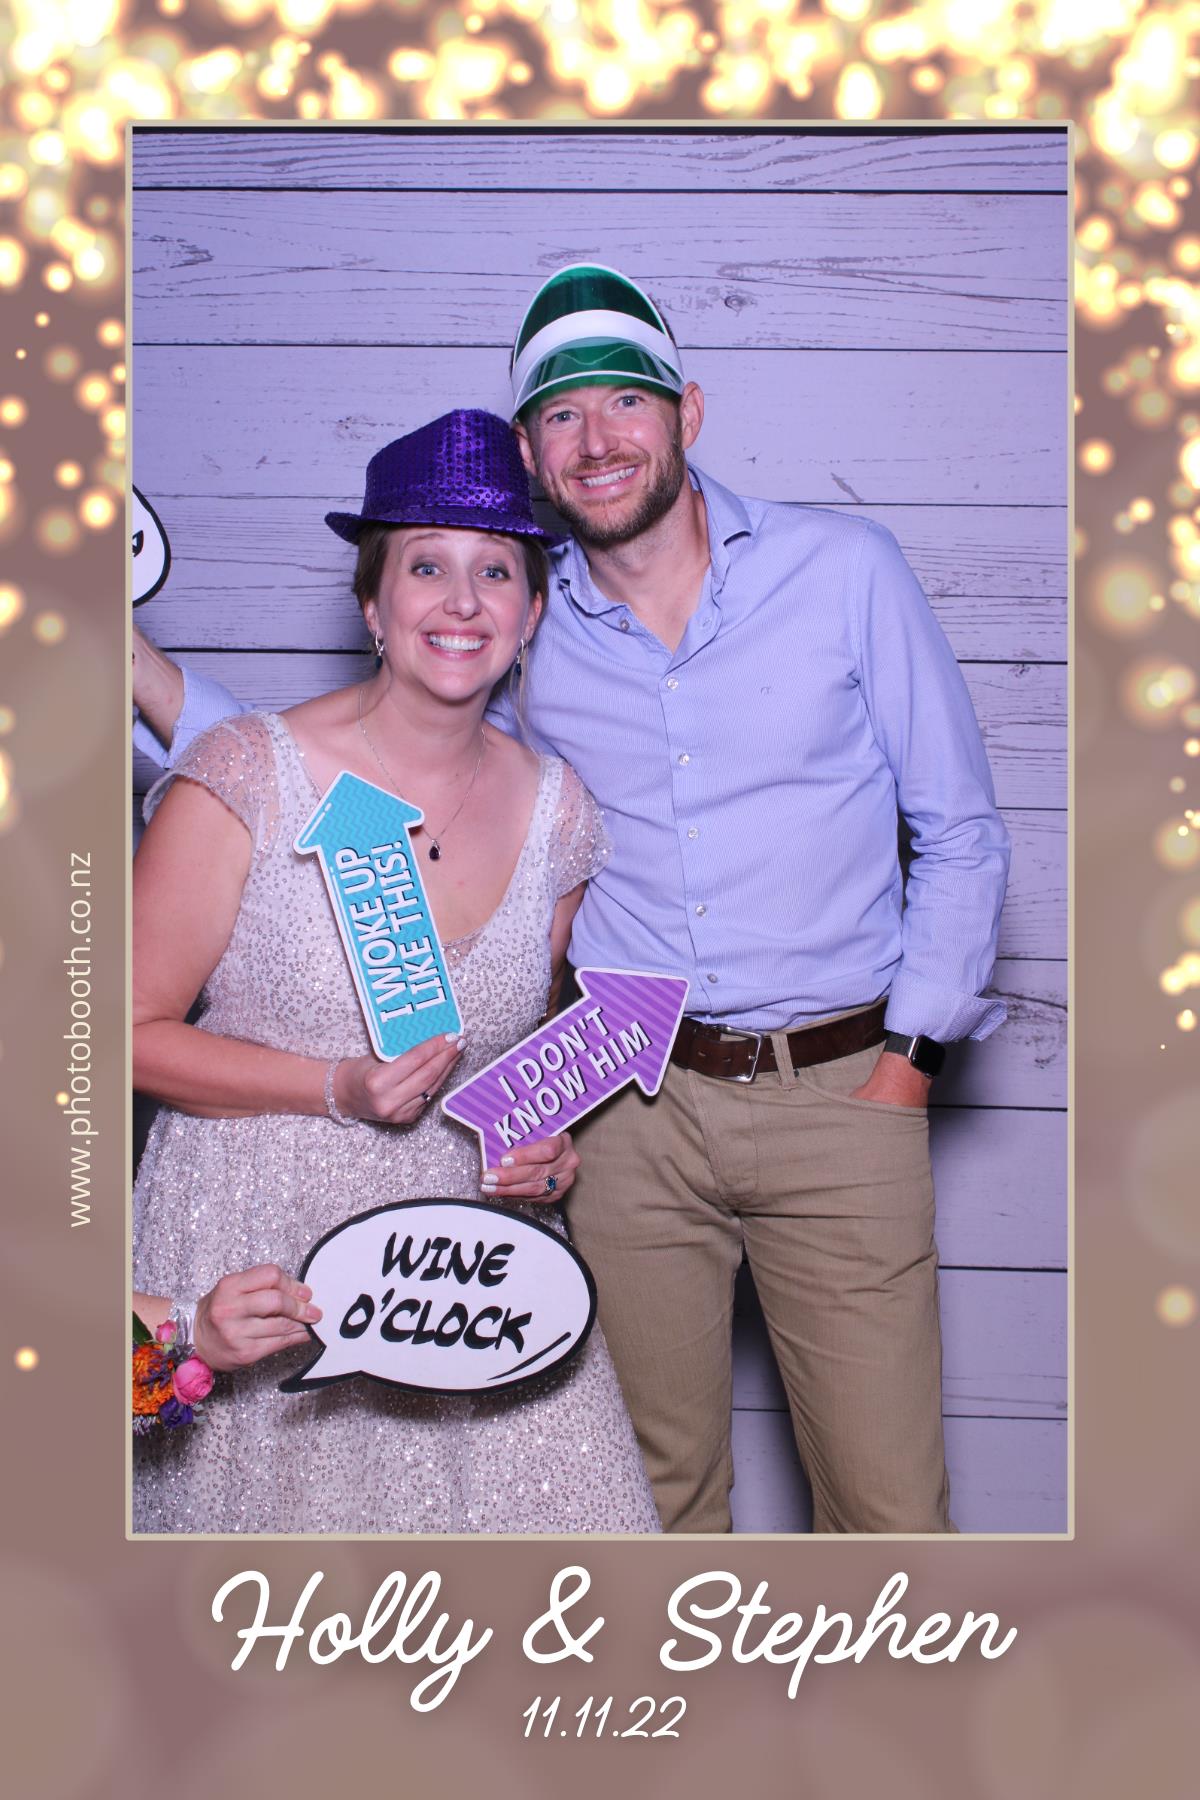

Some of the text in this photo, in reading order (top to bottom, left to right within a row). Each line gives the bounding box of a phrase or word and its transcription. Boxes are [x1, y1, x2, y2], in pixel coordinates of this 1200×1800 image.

[335, 847, 414, 1024] I WOKE UP
[371, 840, 448, 1012] LIKE THIS!
[494, 1020, 653, 1149] KNOW HIM
[498, 1006, 612, 1103] I DON'T
[381, 1231, 516, 1287] WINE
[338, 1287, 533, 1353] O'CLOCK
